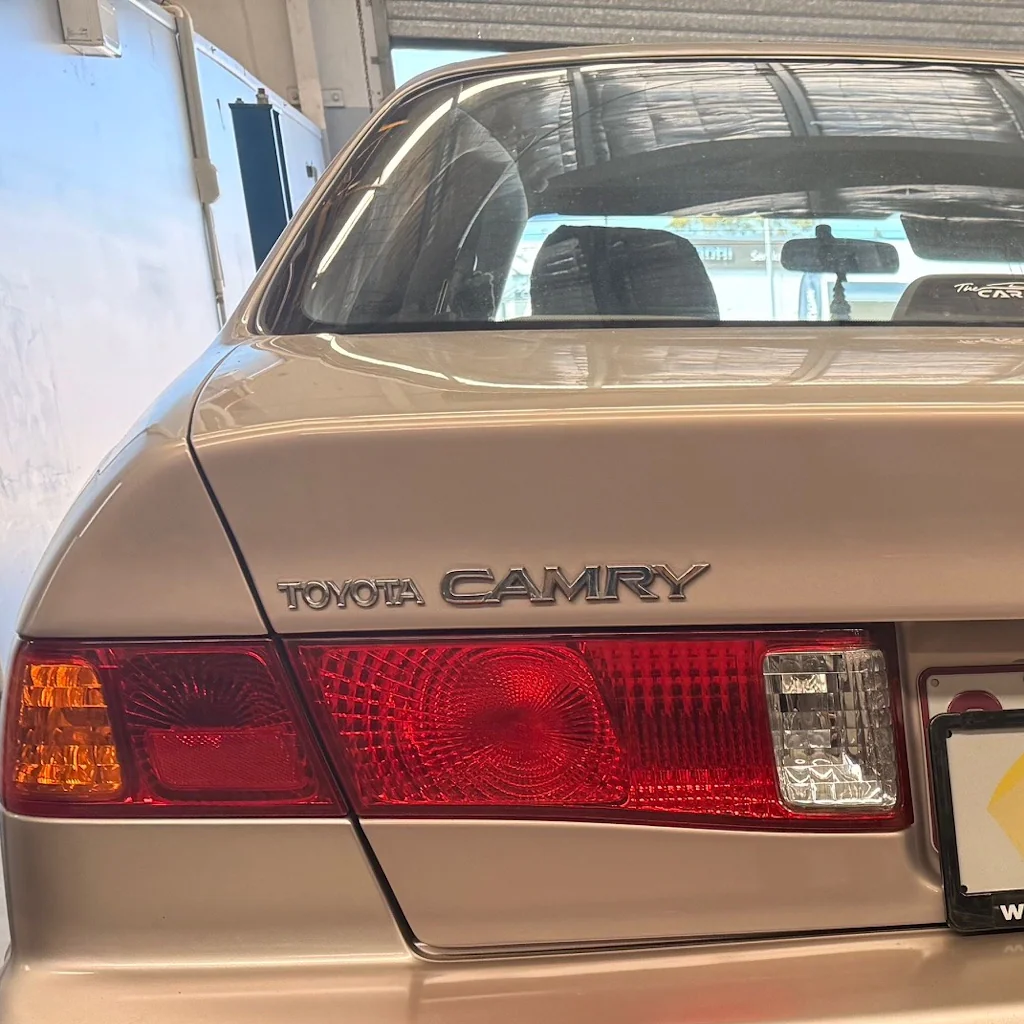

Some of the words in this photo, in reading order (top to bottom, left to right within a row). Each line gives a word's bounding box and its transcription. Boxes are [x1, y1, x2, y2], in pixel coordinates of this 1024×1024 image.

[954, 282, 982, 293] The
[277, 577, 426, 610] TOYOTA
[440, 563, 711, 607] CAMRY
